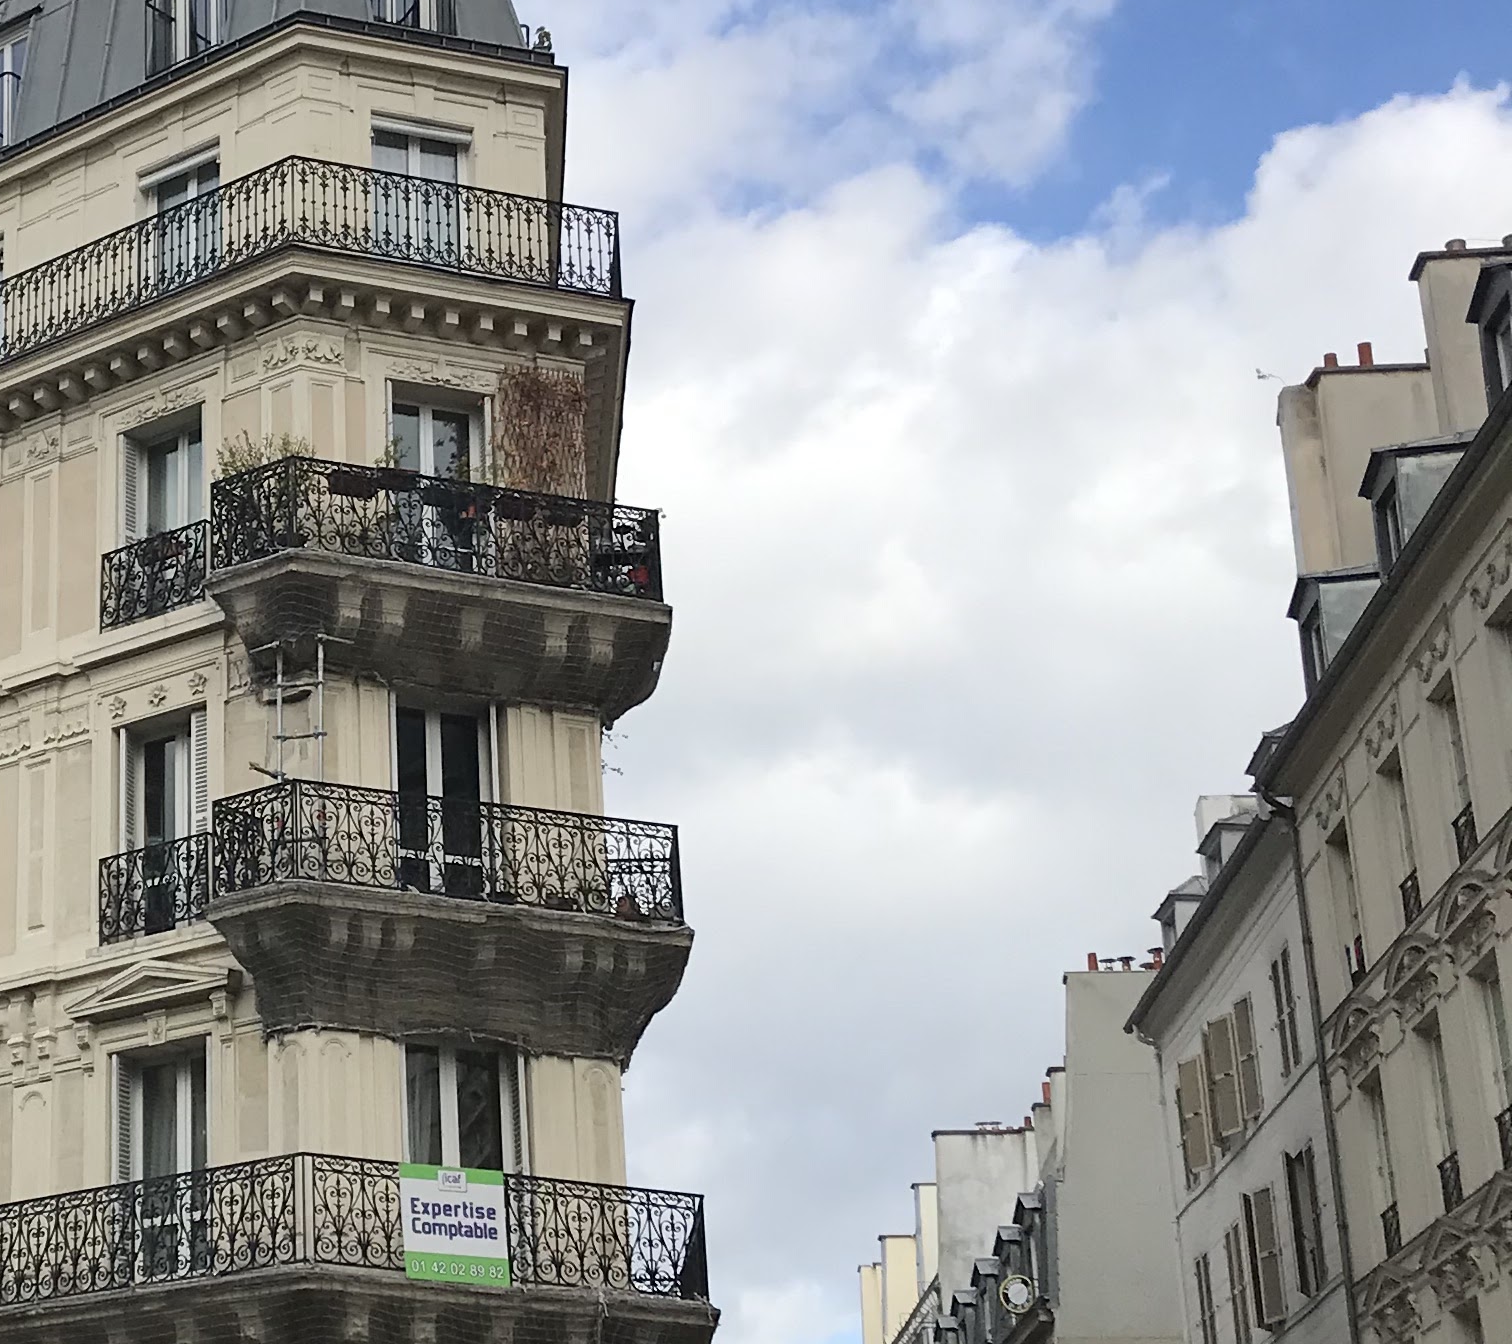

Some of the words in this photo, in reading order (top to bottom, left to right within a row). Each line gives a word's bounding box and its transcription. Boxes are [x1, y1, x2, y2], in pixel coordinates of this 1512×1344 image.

[410, 1197, 496, 1220] Expertise
[411, 1217, 498, 1240] Comptable
[411, 1259, 426, 1272] 01
[431, 1261, 447, 1274] 42
[450, 1262, 466, 1276] 02
[469, 1264, 485, 1277] 89
[489, 1266, 504, 1279] 82
